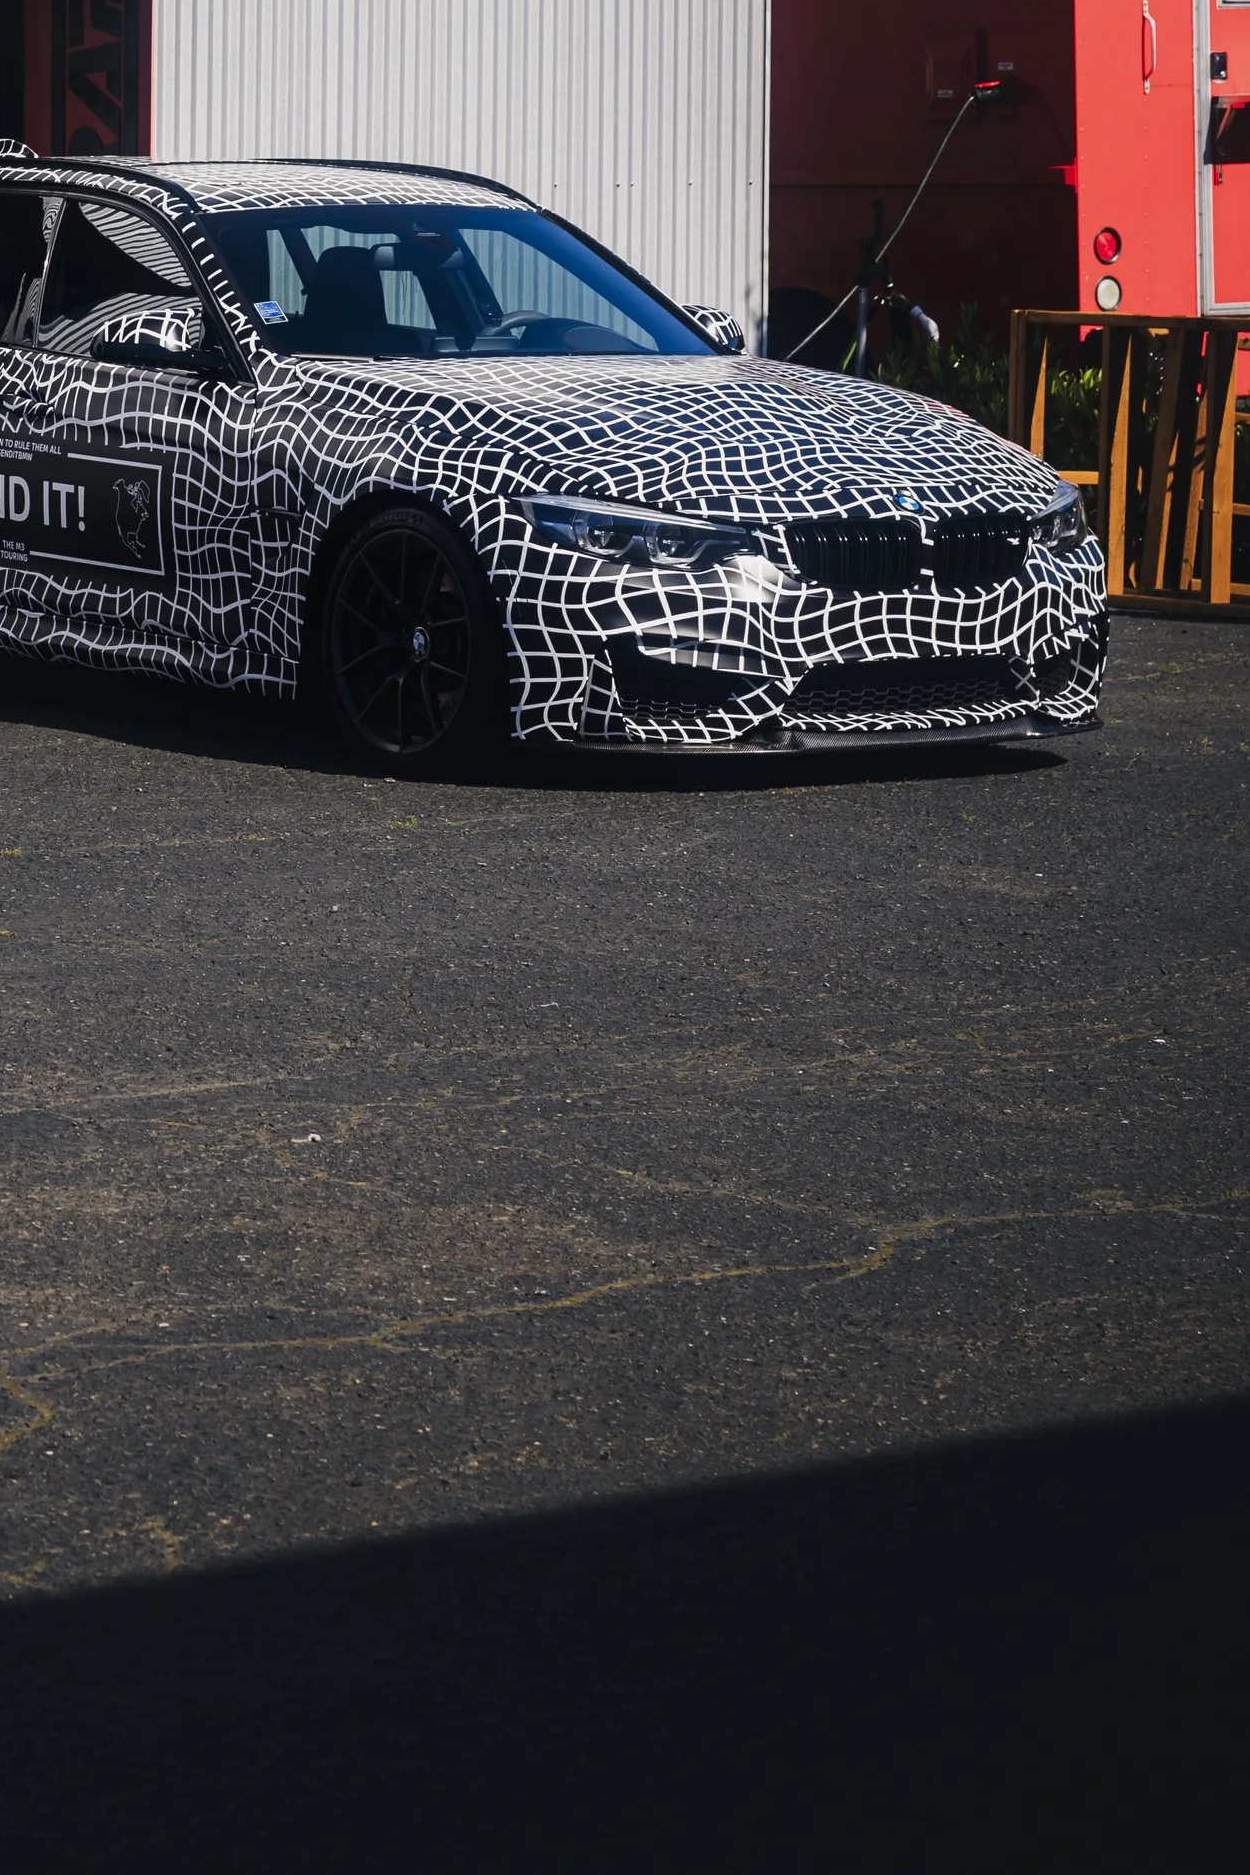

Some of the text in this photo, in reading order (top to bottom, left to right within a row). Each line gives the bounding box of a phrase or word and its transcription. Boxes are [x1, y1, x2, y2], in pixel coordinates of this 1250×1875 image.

[5, 439, 13, 448] TO
[14, 440, 30, 451] RULE
[31, 442, 49, 453] THEM
[49, 445, 62, 455] ALL
[43, 480, 86, 532] IT!
[2, 540, 25, 551] THE M3
[0, 550, 28, 562] TOURING
